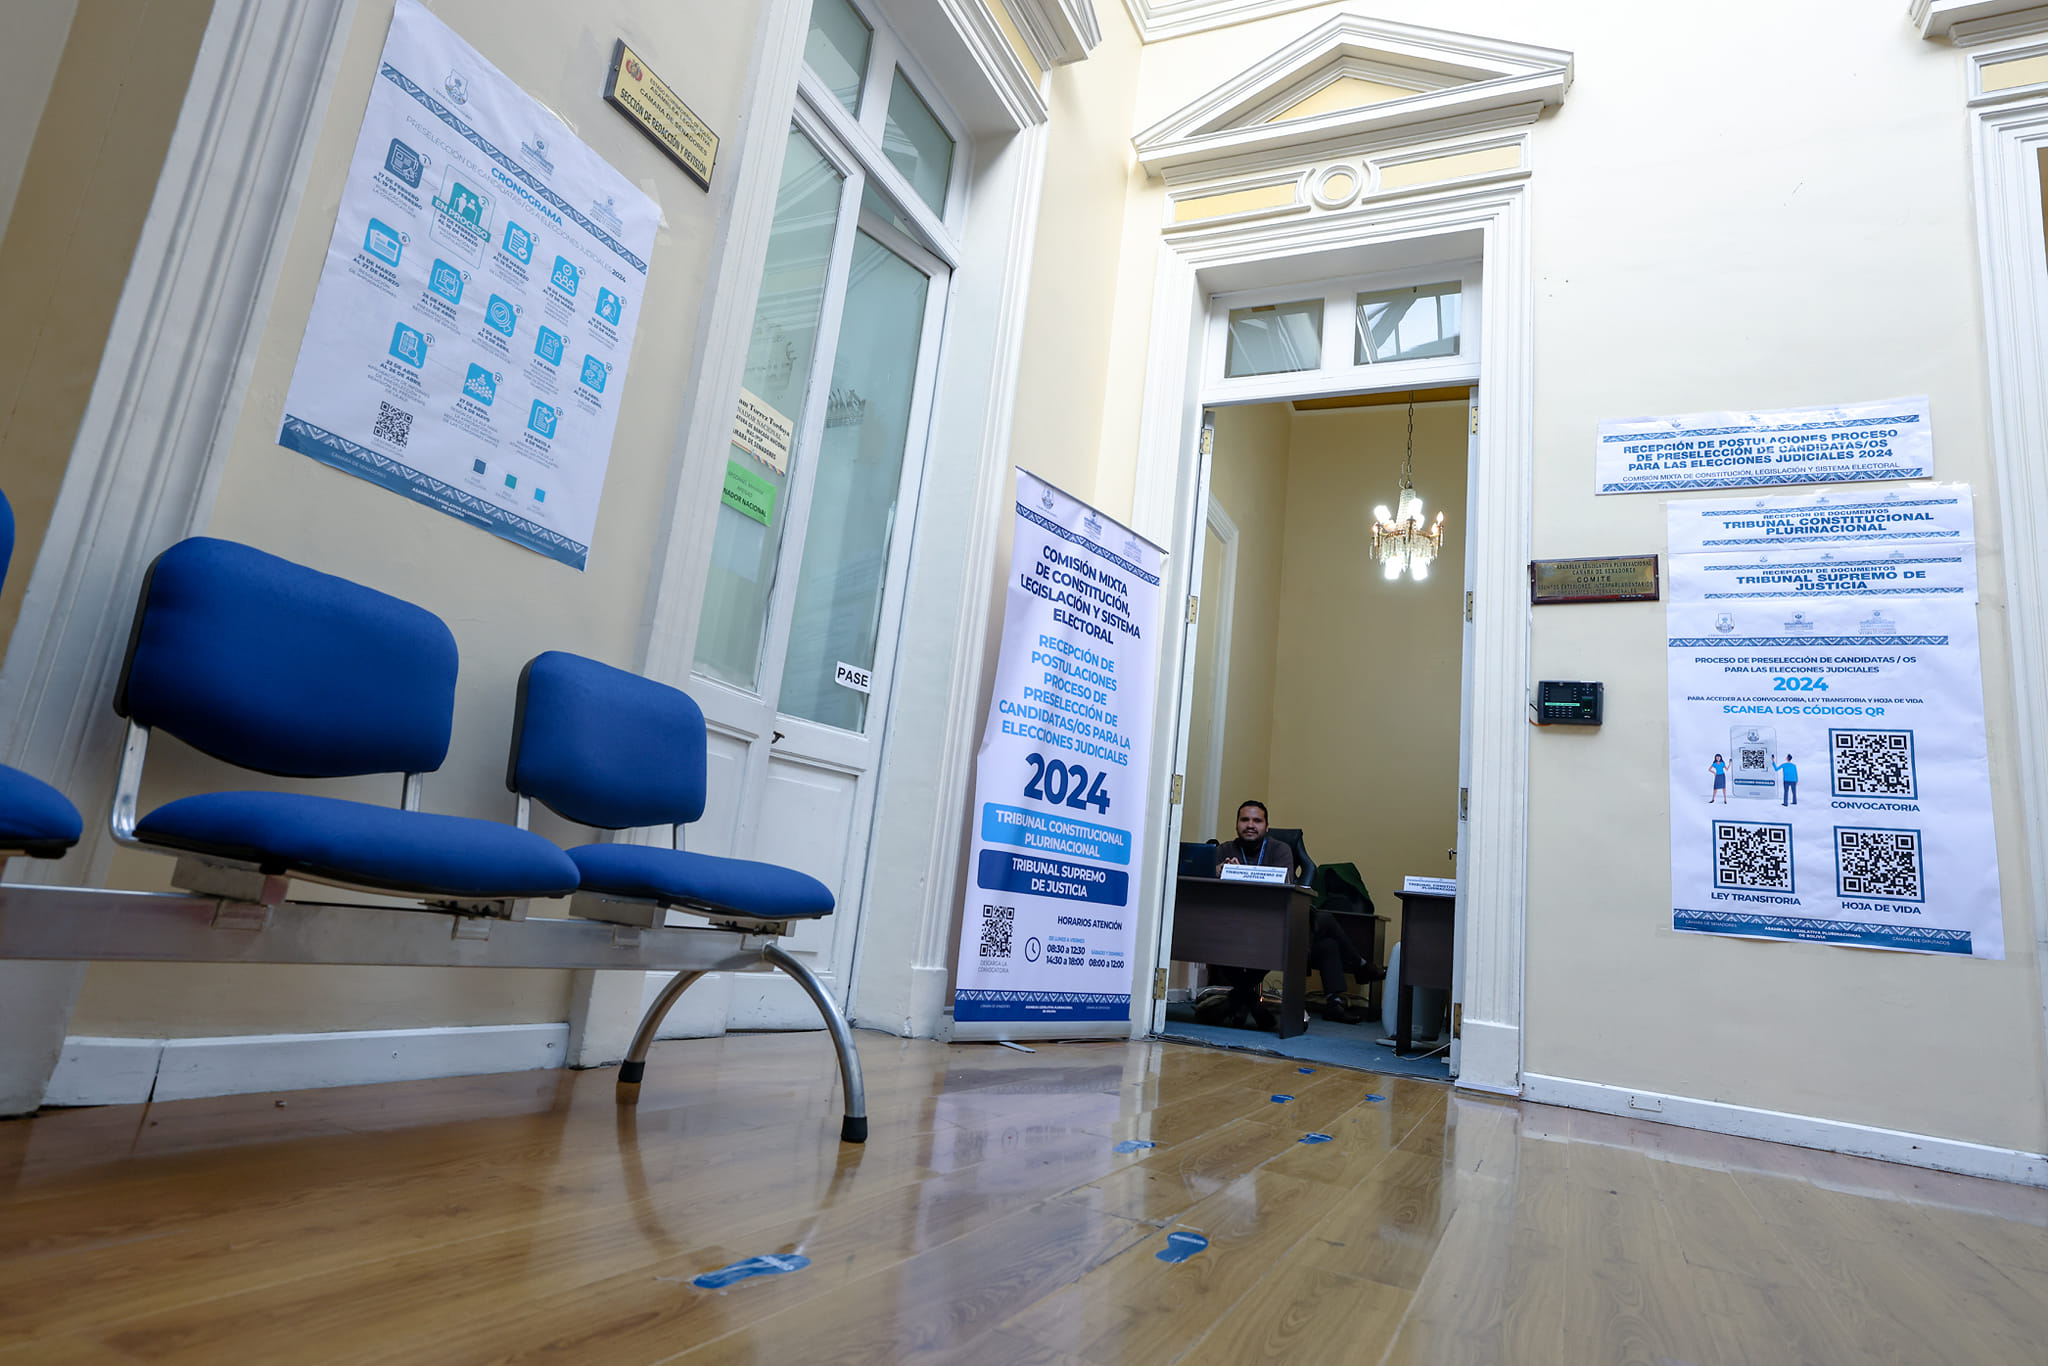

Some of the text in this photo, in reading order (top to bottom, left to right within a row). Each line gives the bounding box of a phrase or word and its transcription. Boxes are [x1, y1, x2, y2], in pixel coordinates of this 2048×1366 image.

[620, 87, 644, 117] SECCIÓN
[642, 108, 651, 124] DE
[650, 115, 680, 151] REDACCIÓN
[679, 142, 684, 155] Y
[683, 145, 707, 176] REVISIÓN
[640, 88, 665, 117] CAMARA
[664, 111, 674, 125] DE
[673, 119, 708, 156] SENADORES
[491, 167, 562, 226] CRONOGRAMA
[436, 200, 447, 213] EN
[449, 208, 488, 238] PROCESO
[612, 268, 626, 282] 2024
[746, 428, 763, 443] MAS-IPSP
[1624, 429, 1898, 454] RECEPCIÓN DE POSTUACIONES PROCESO
[1628, 449, 1893, 471] PARA LAS ELECCIONES JUDICIALES 2024
[1636, 439, 1888, 462] DE PRESELECCIÓN DE CANDIDATAS/OS
[724, 487, 742, 503] NADOR
[741, 497, 766, 518] NACIONAL
[1827, 508, 1889, 516] DOCUMENTOS
[1723, 512, 1934, 529] TRIBUNAL CONSTITUCIONAL
[1766, 523, 1886, 535] PLURINACIONAL
[1043, 544, 1128, 597] COMISIÓN MIXTA
[1736, 571, 1926, 584] TRIBUNAL SUPREMO DE
[1035, 561, 1131, 617] DE CONSTITUCIÓN,
[1795, 581, 1868, 591] JUSTICIA
[1020, 573, 1141, 639] LEGISLACIÓN Y SISTEMA
[1053, 608, 1114, 644] ELECTORAL
[1039, 633, 1115, 673] RECEPCIÓN DE
[1833, 656, 1895, 664] CANDIDATAS
[1897, 656, 1901, 664] /
[1902, 656, 1917, 664] OS
[836, 665, 869, 688] PASE
[1032, 650, 1117, 692] POSTULACIONES
[1044, 672, 1108, 706] PROCESO DE
[1773, 677, 1829, 691] 2024
[1024, 686, 1118, 727] PRESELECCIÓN DE
[1723, 705, 1885, 716] SCANEA LOS CÓDIGOS QR
[999, 699, 1131, 750] CANDIDATAS/OS PARA LA
[1001, 720, 1128, 766] ELECCIONES JUDICIALES
[1023, 752, 1110, 815] 2024
[1831, 801, 1920, 813] CONVOCATORIA
[996, 809, 1123, 847] TRIBUNAL CONSTITUCIONAL
[1024, 832, 1099, 857] PLURINACIONAL
[1012, 857, 1106, 884] TRIBUNAL SUPREMO
[1031, 878, 1088, 897] DE JUSTICIA
[1711, 892, 1801, 906] LEY TRANSITORIA
[1842, 901, 1921, 914] HOJA DE VIDA
[1058, 915, 1123, 930] HORARIOS ATENCIÓN
[1047, 944, 1064, 953] 08:30
[1070, 946, 1085, 955] 12:30
[1047, 956, 1062, 964] 14:30
[1068, 957, 1084, 966] 18:00
[1089, 959, 1105, 967] 08:00
[1110, 960, 1124, 968] 12:00
